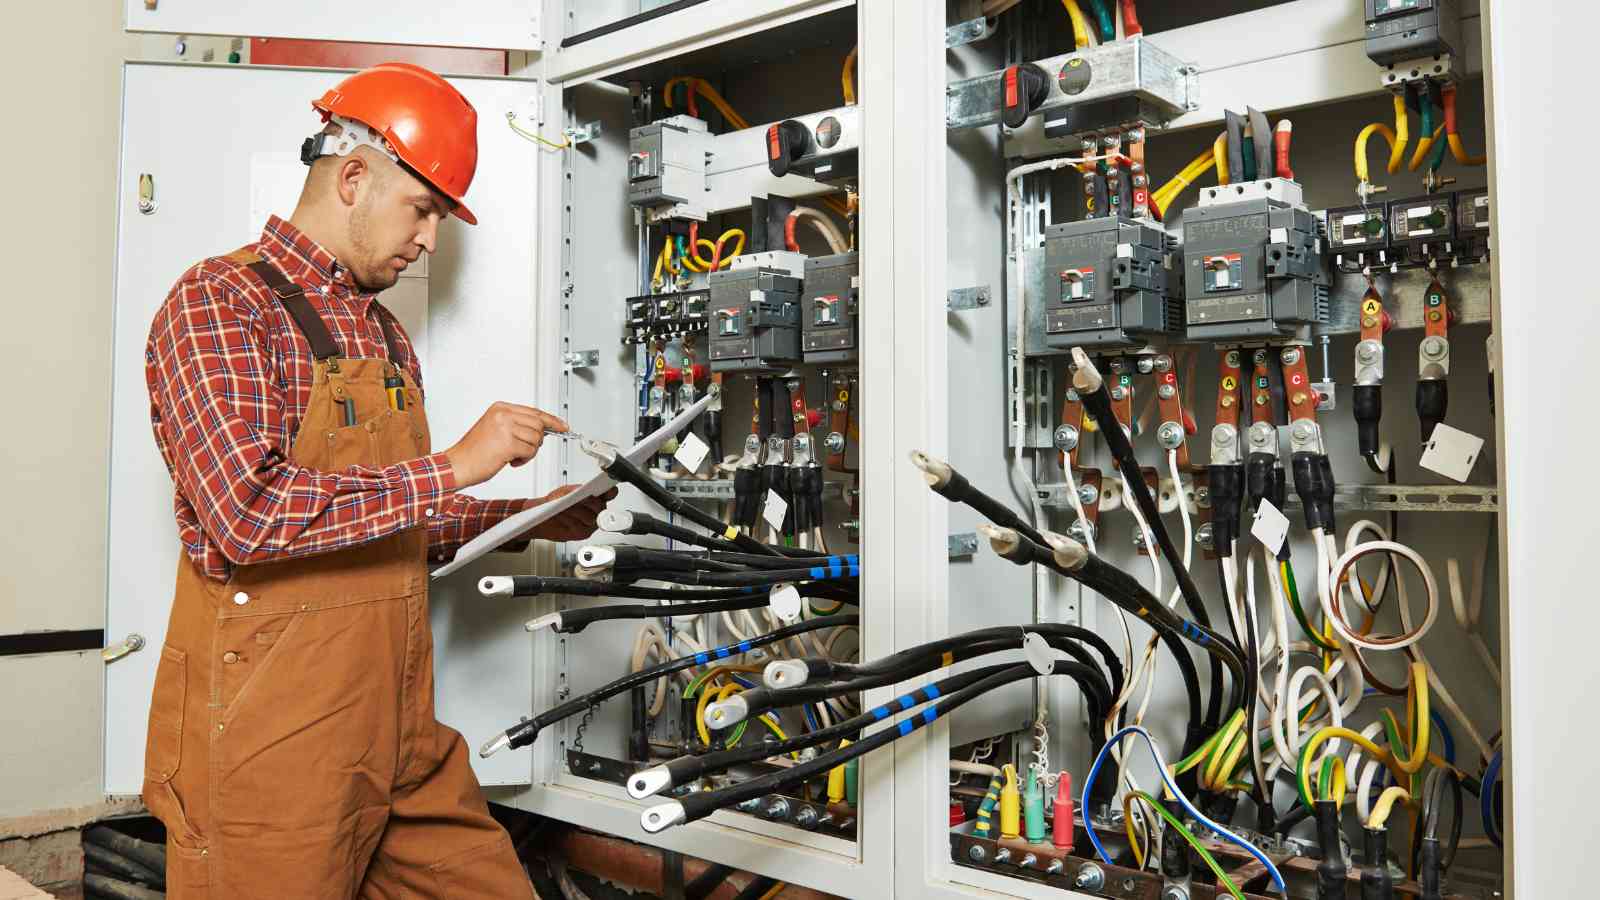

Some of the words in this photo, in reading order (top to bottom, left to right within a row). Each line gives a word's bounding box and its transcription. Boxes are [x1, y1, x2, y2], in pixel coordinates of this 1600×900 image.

[1136, 192, 1144, 202] C
[1430, 294, 1440, 305] B
[1366, 301, 1376, 311] A
[1121, 375, 1129, 384] B
[1166, 373, 1174, 382] C
[1259, 377, 1267, 388] B
[1292, 375, 1301, 385] C
